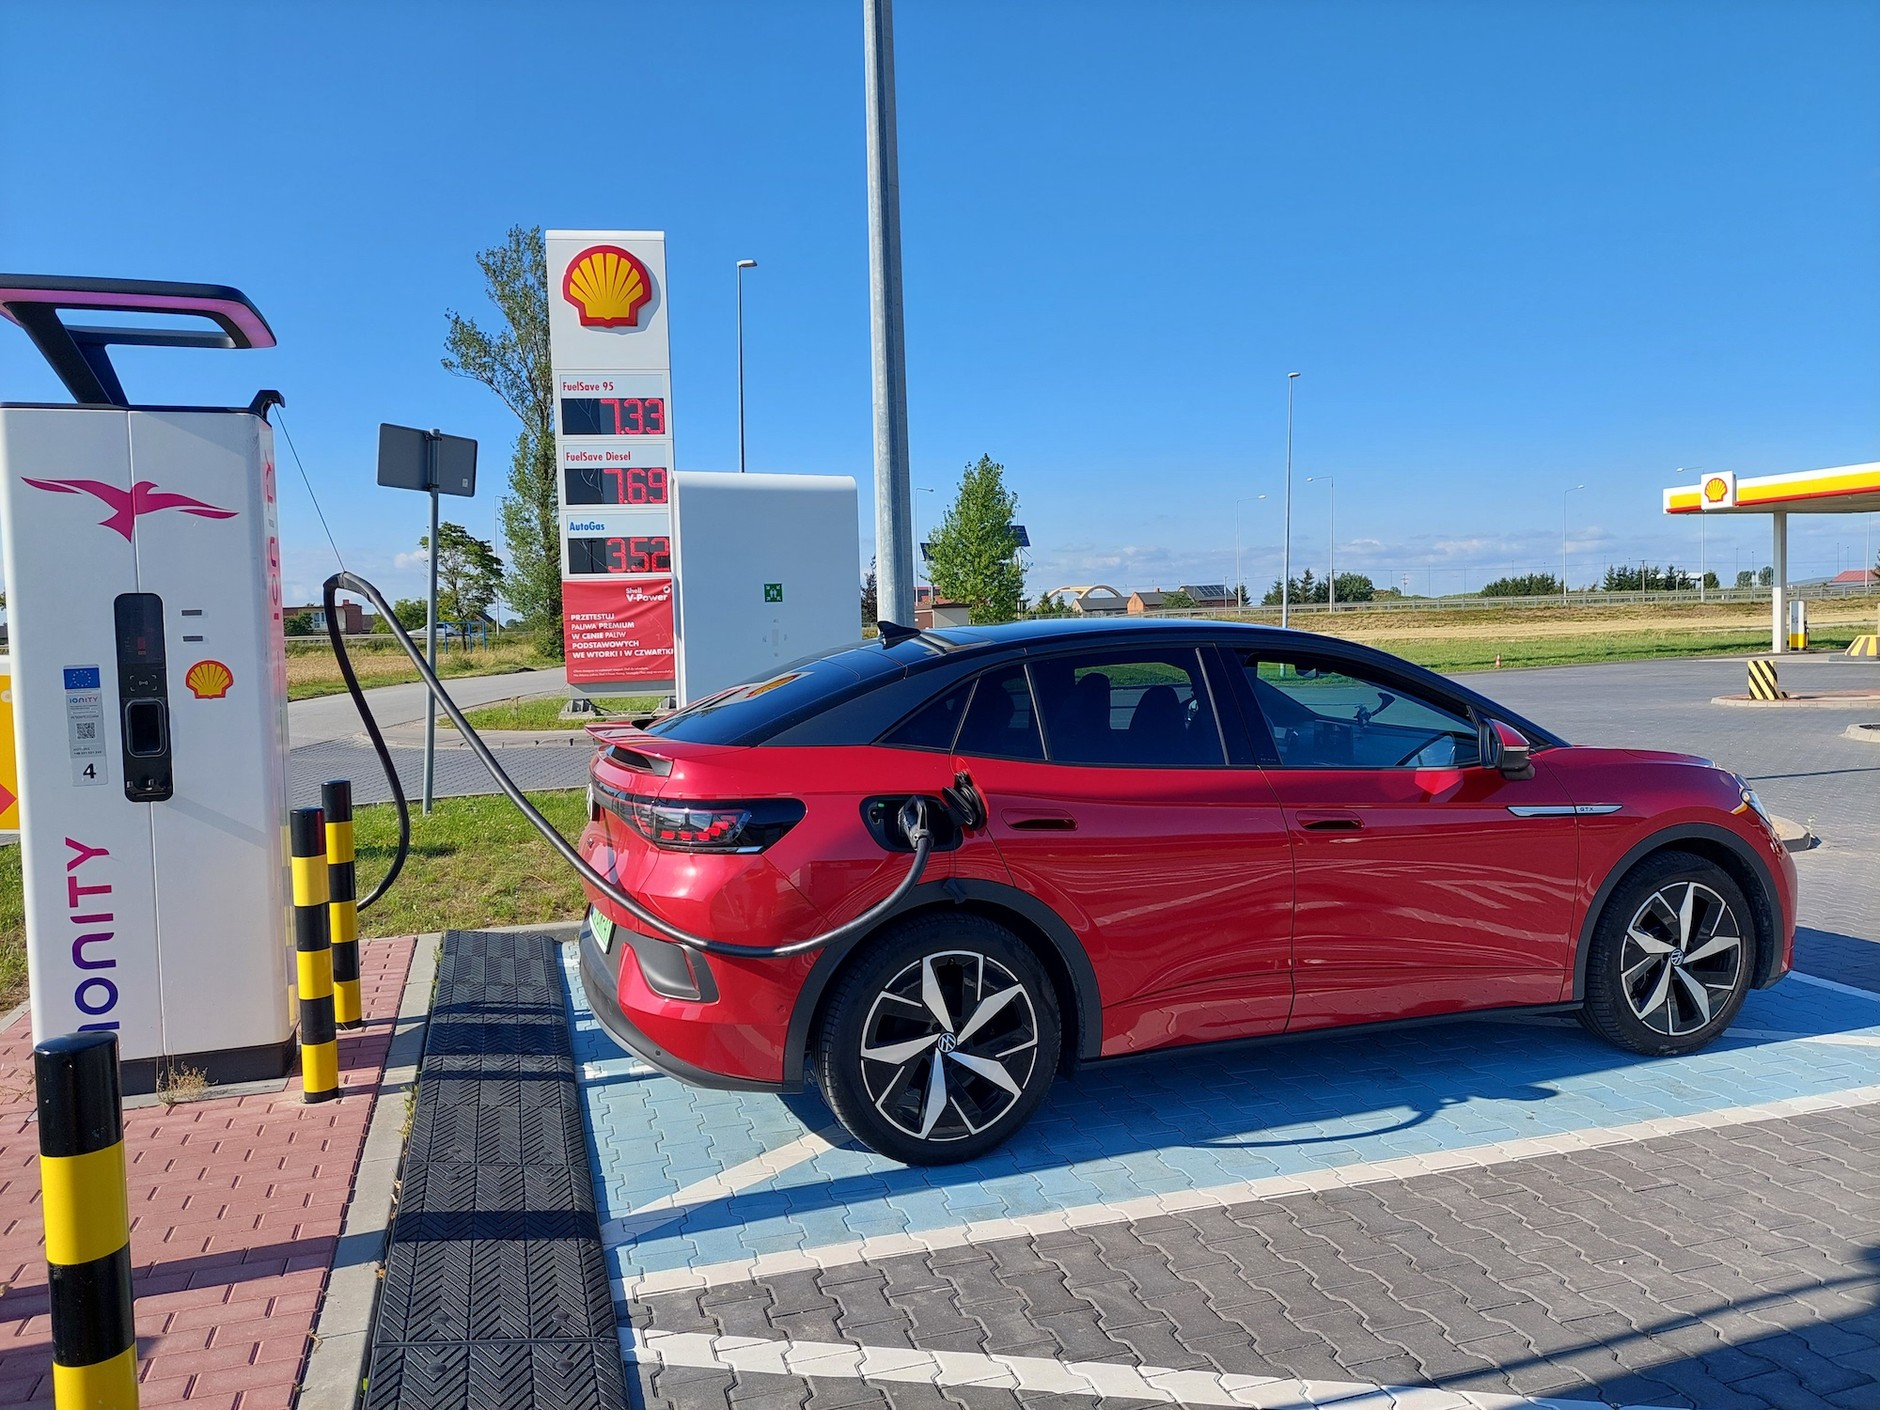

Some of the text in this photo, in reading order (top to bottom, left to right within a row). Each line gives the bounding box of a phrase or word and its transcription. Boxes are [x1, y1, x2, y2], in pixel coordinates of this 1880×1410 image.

[562, 381, 614, 391] FuelSave 95
[600, 398, 664, 434] 7.33
[566, 451, 631, 461] FuelSave Diesel
[603, 468, 667, 504] 7.69
[569, 521, 605, 531] AutoGas
[606, 537, 671, 573] 3.52
[626, 594, 667, 602] V-Power
[572, 640, 640, 649] PODSTAWOWYCH
[572, 651, 585, 659] WE
[586, 650, 618, 658] WTORKI
[634, 648, 673, 656] CZWARTKI
[69, 696, 98, 704] IONITY
[82, 763, 97, 779] 4
